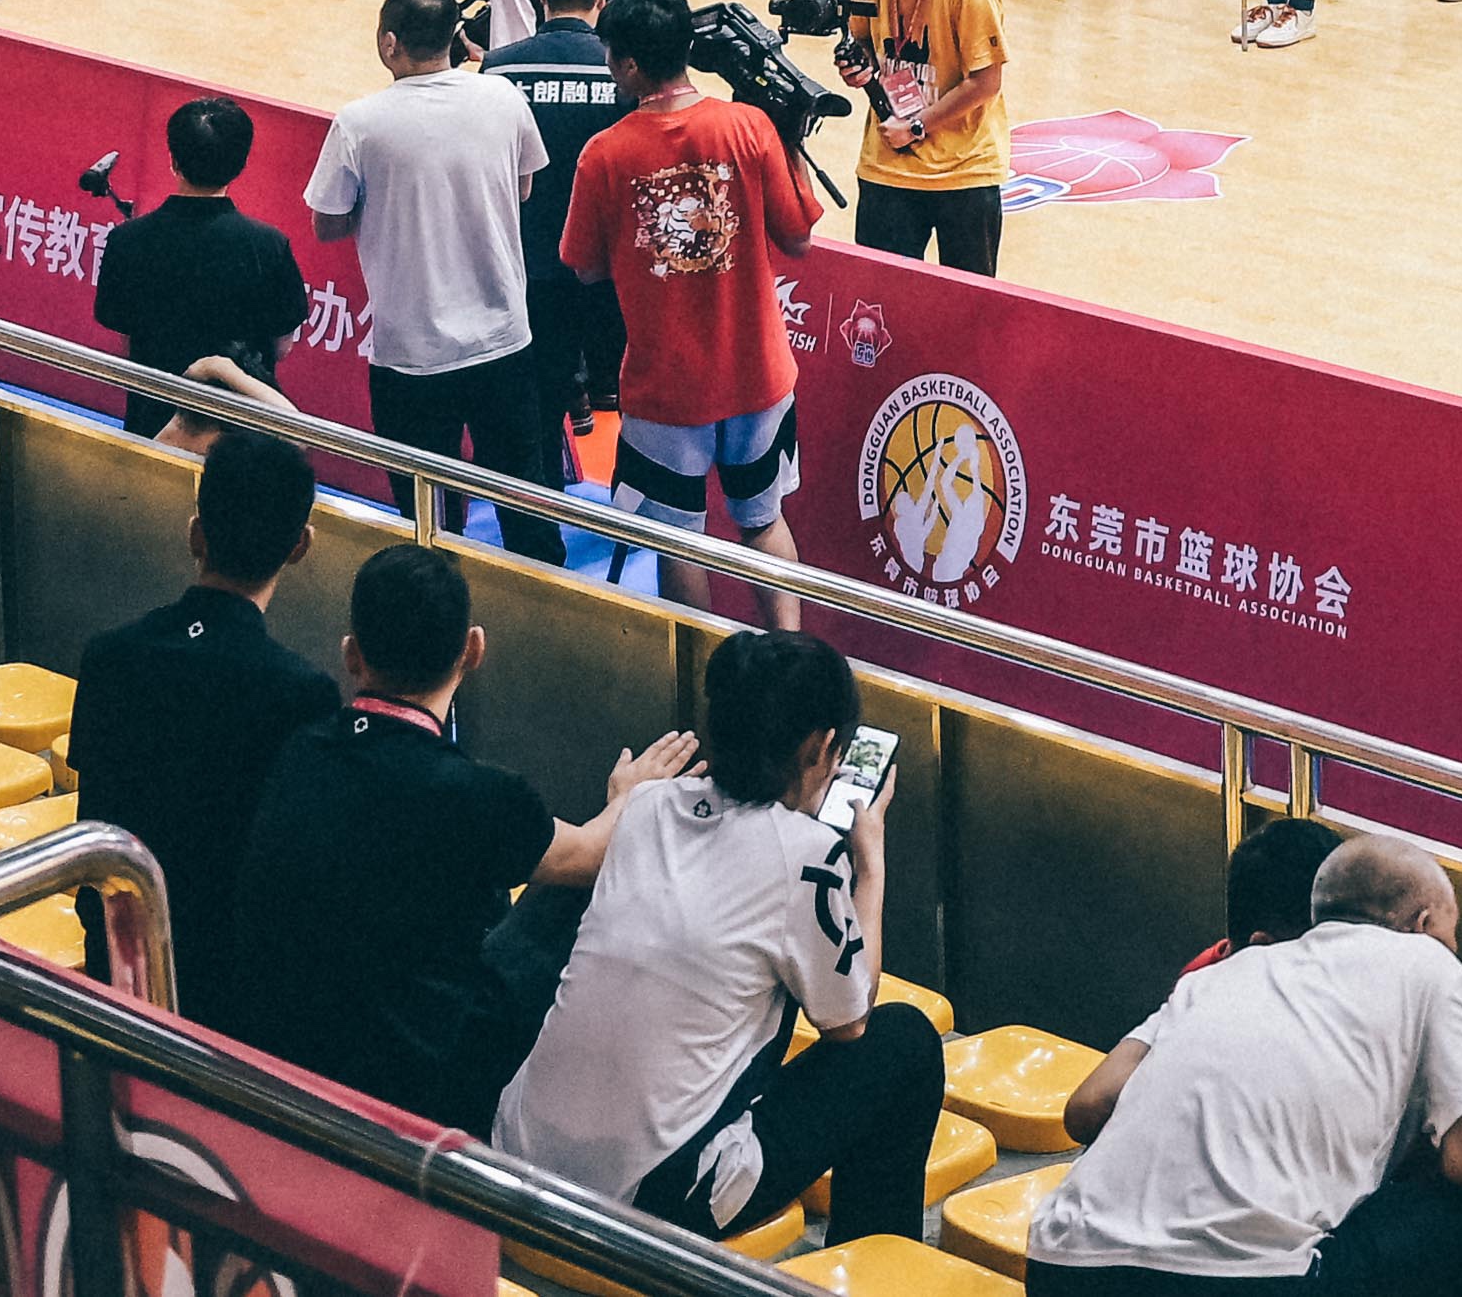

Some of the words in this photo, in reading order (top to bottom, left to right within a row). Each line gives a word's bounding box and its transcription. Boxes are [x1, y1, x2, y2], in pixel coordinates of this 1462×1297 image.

[863, 397, 902, 507] DONGGUAN
[899, 379, 988, 420] BASKETBALL
[987, 416, 1024, 548] ASSOCIATION
[1040, 540, 1129, 578] DONGGUAN
[1133, 566, 1232, 609] BASKETBALL
[1238, 598, 1349, 641] ASSOCIATION
[1043, 492, 1353, 620] 东莞市篮球协会
